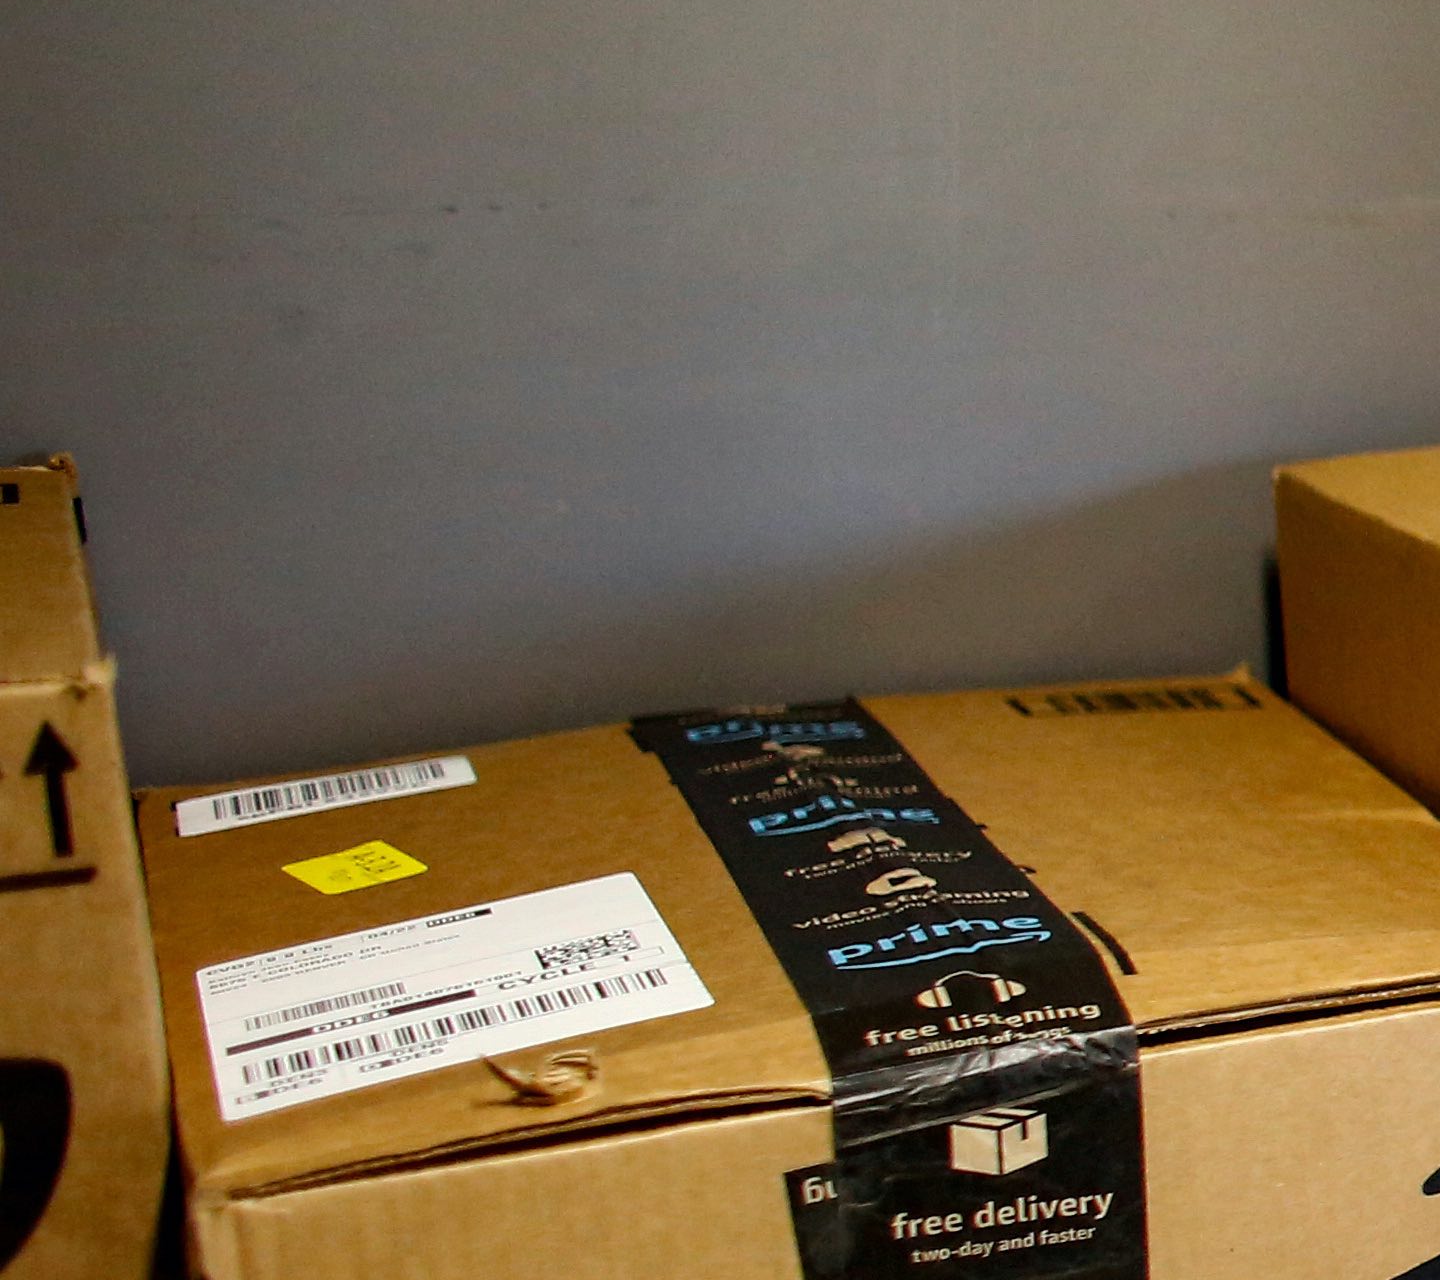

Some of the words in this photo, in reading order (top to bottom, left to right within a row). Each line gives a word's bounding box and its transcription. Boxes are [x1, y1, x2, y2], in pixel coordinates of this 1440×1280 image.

[784, 858, 846, 878] free
[792, 906, 878, 930] video
[826, 914, 1043, 967] prime
[309, 1007, 391, 1034] DDE6
[495, 960, 598, 991] CYCLE
[863, 1022, 939, 1048] free
[946, 1002, 1102, 1034] listening
[905, 1035, 990, 1057] millions
[890, 1210, 964, 1242] free
[974, 1190, 1116, 1230] delivery
[911, 1238, 995, 1265] two-day
[998, 1232, 1035, 1253] and
[1038, 1224, 1097, 1248] faster
